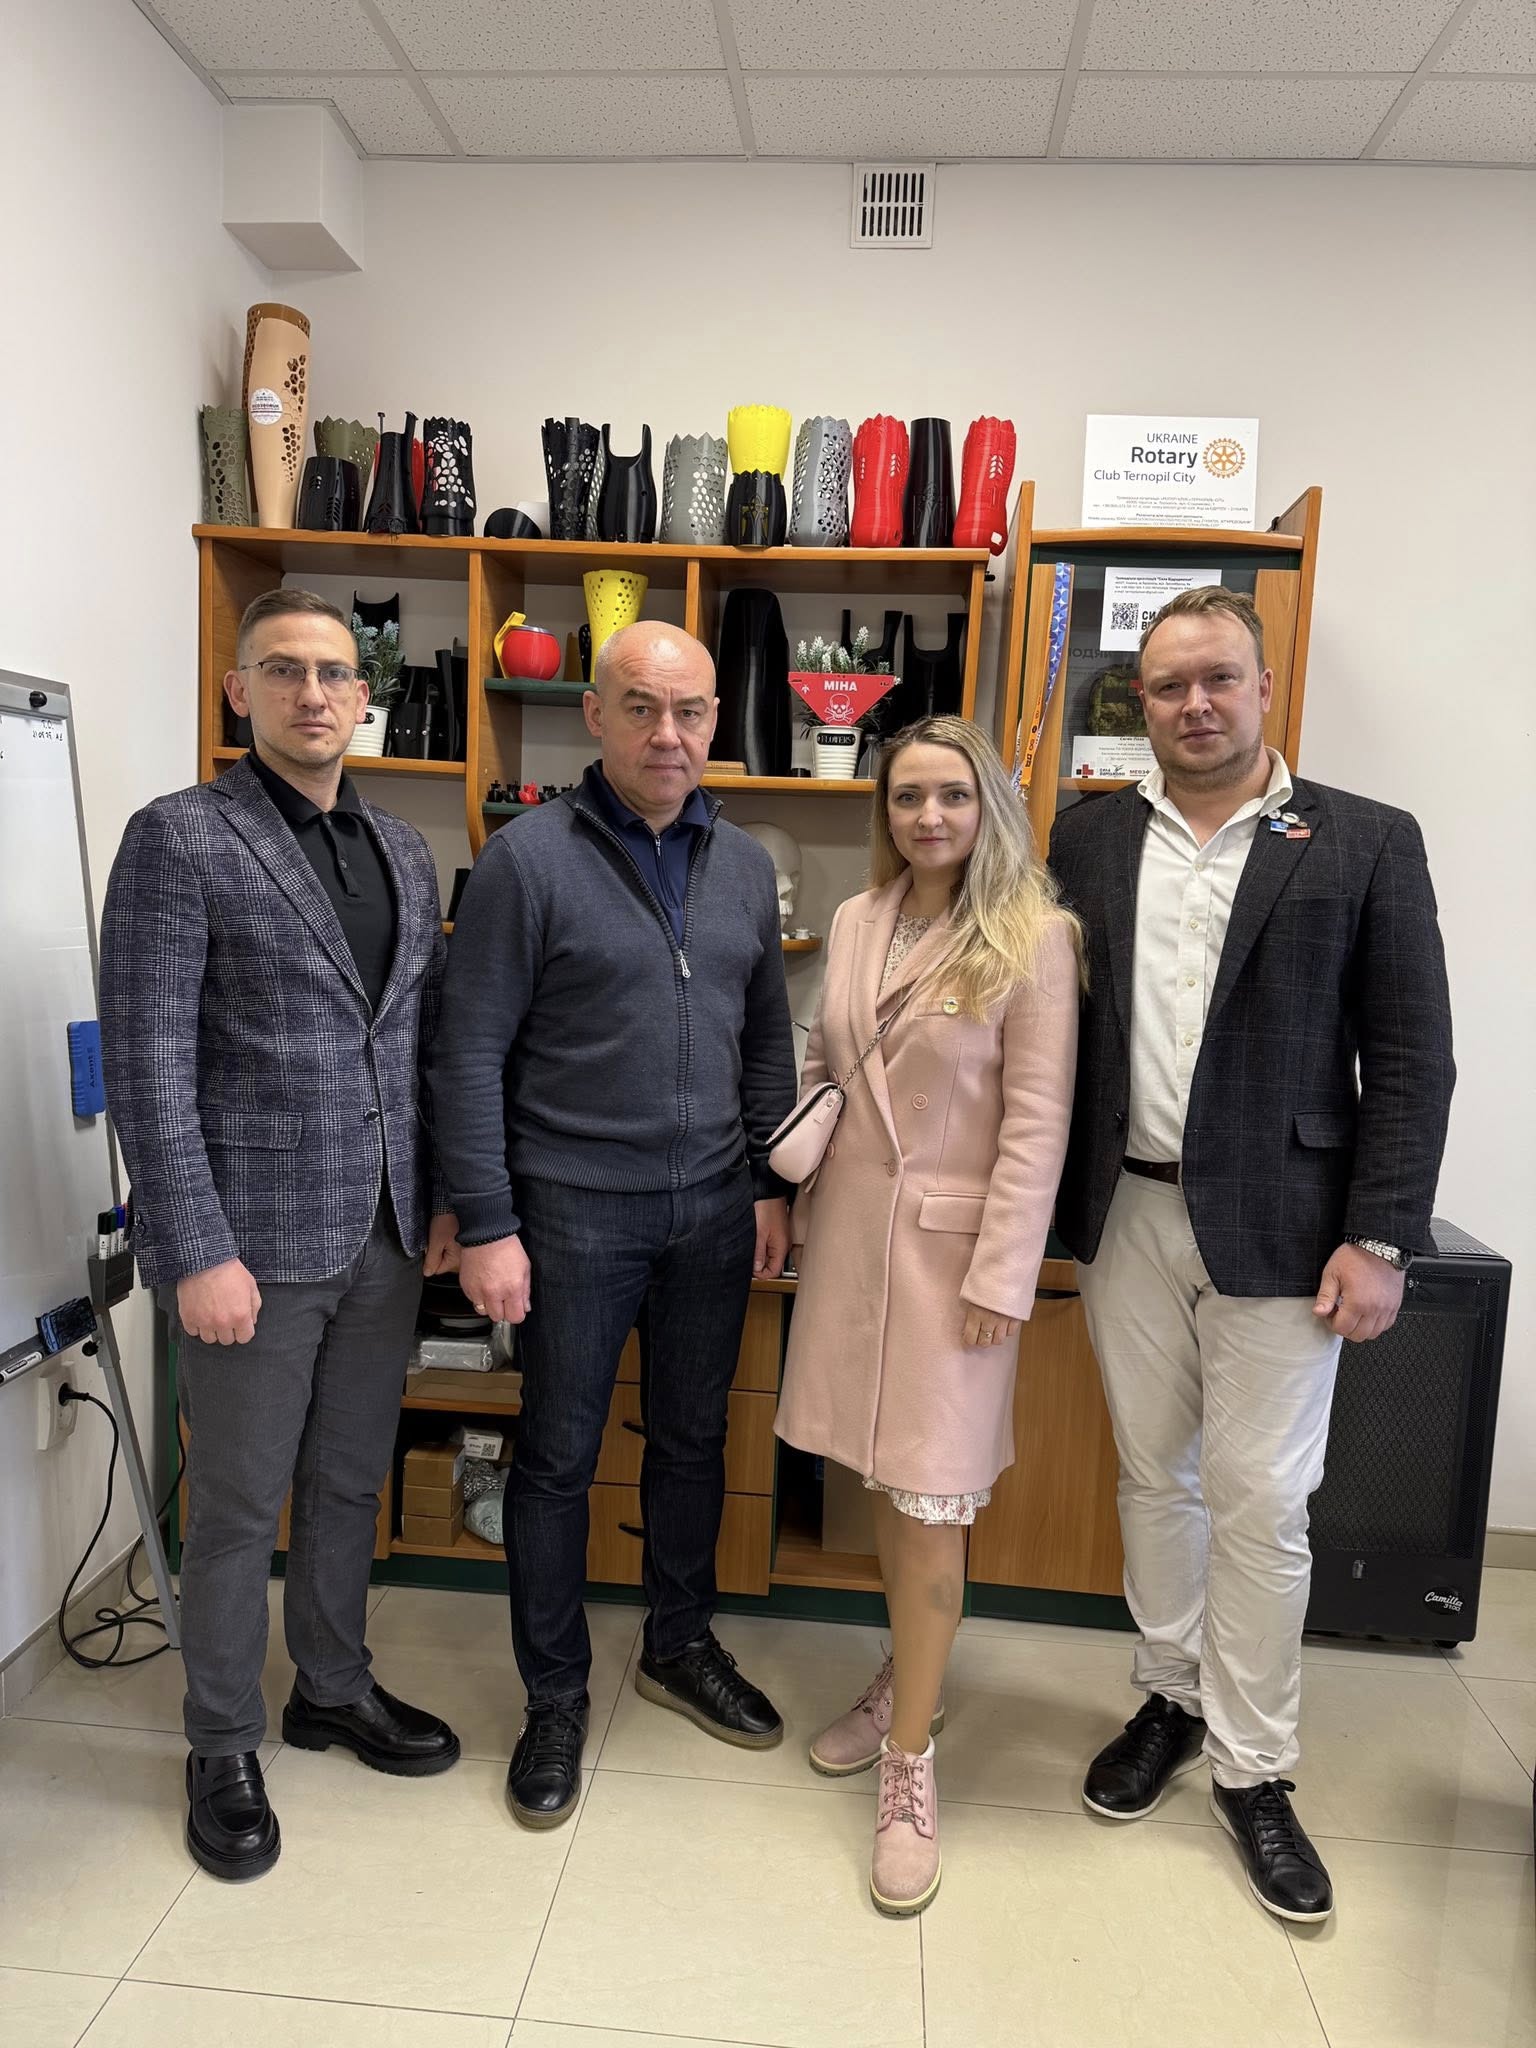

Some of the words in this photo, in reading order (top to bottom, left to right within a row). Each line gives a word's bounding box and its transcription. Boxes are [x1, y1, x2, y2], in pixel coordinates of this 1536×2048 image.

[1147, 433, 1198, 444] UKRAINE
[1131, 446, 1198, 468] Rotary
[1094, 469, 1121, 481] Club
[1124, 470, 1170, 484] Ternopil
[1173, 472, 1196, 485] City
[824, 680, 858, 692] МІНА
[821, 736, 852, 744] FLOWERS
[1424, 1591, 1463, 1607] Camilla
